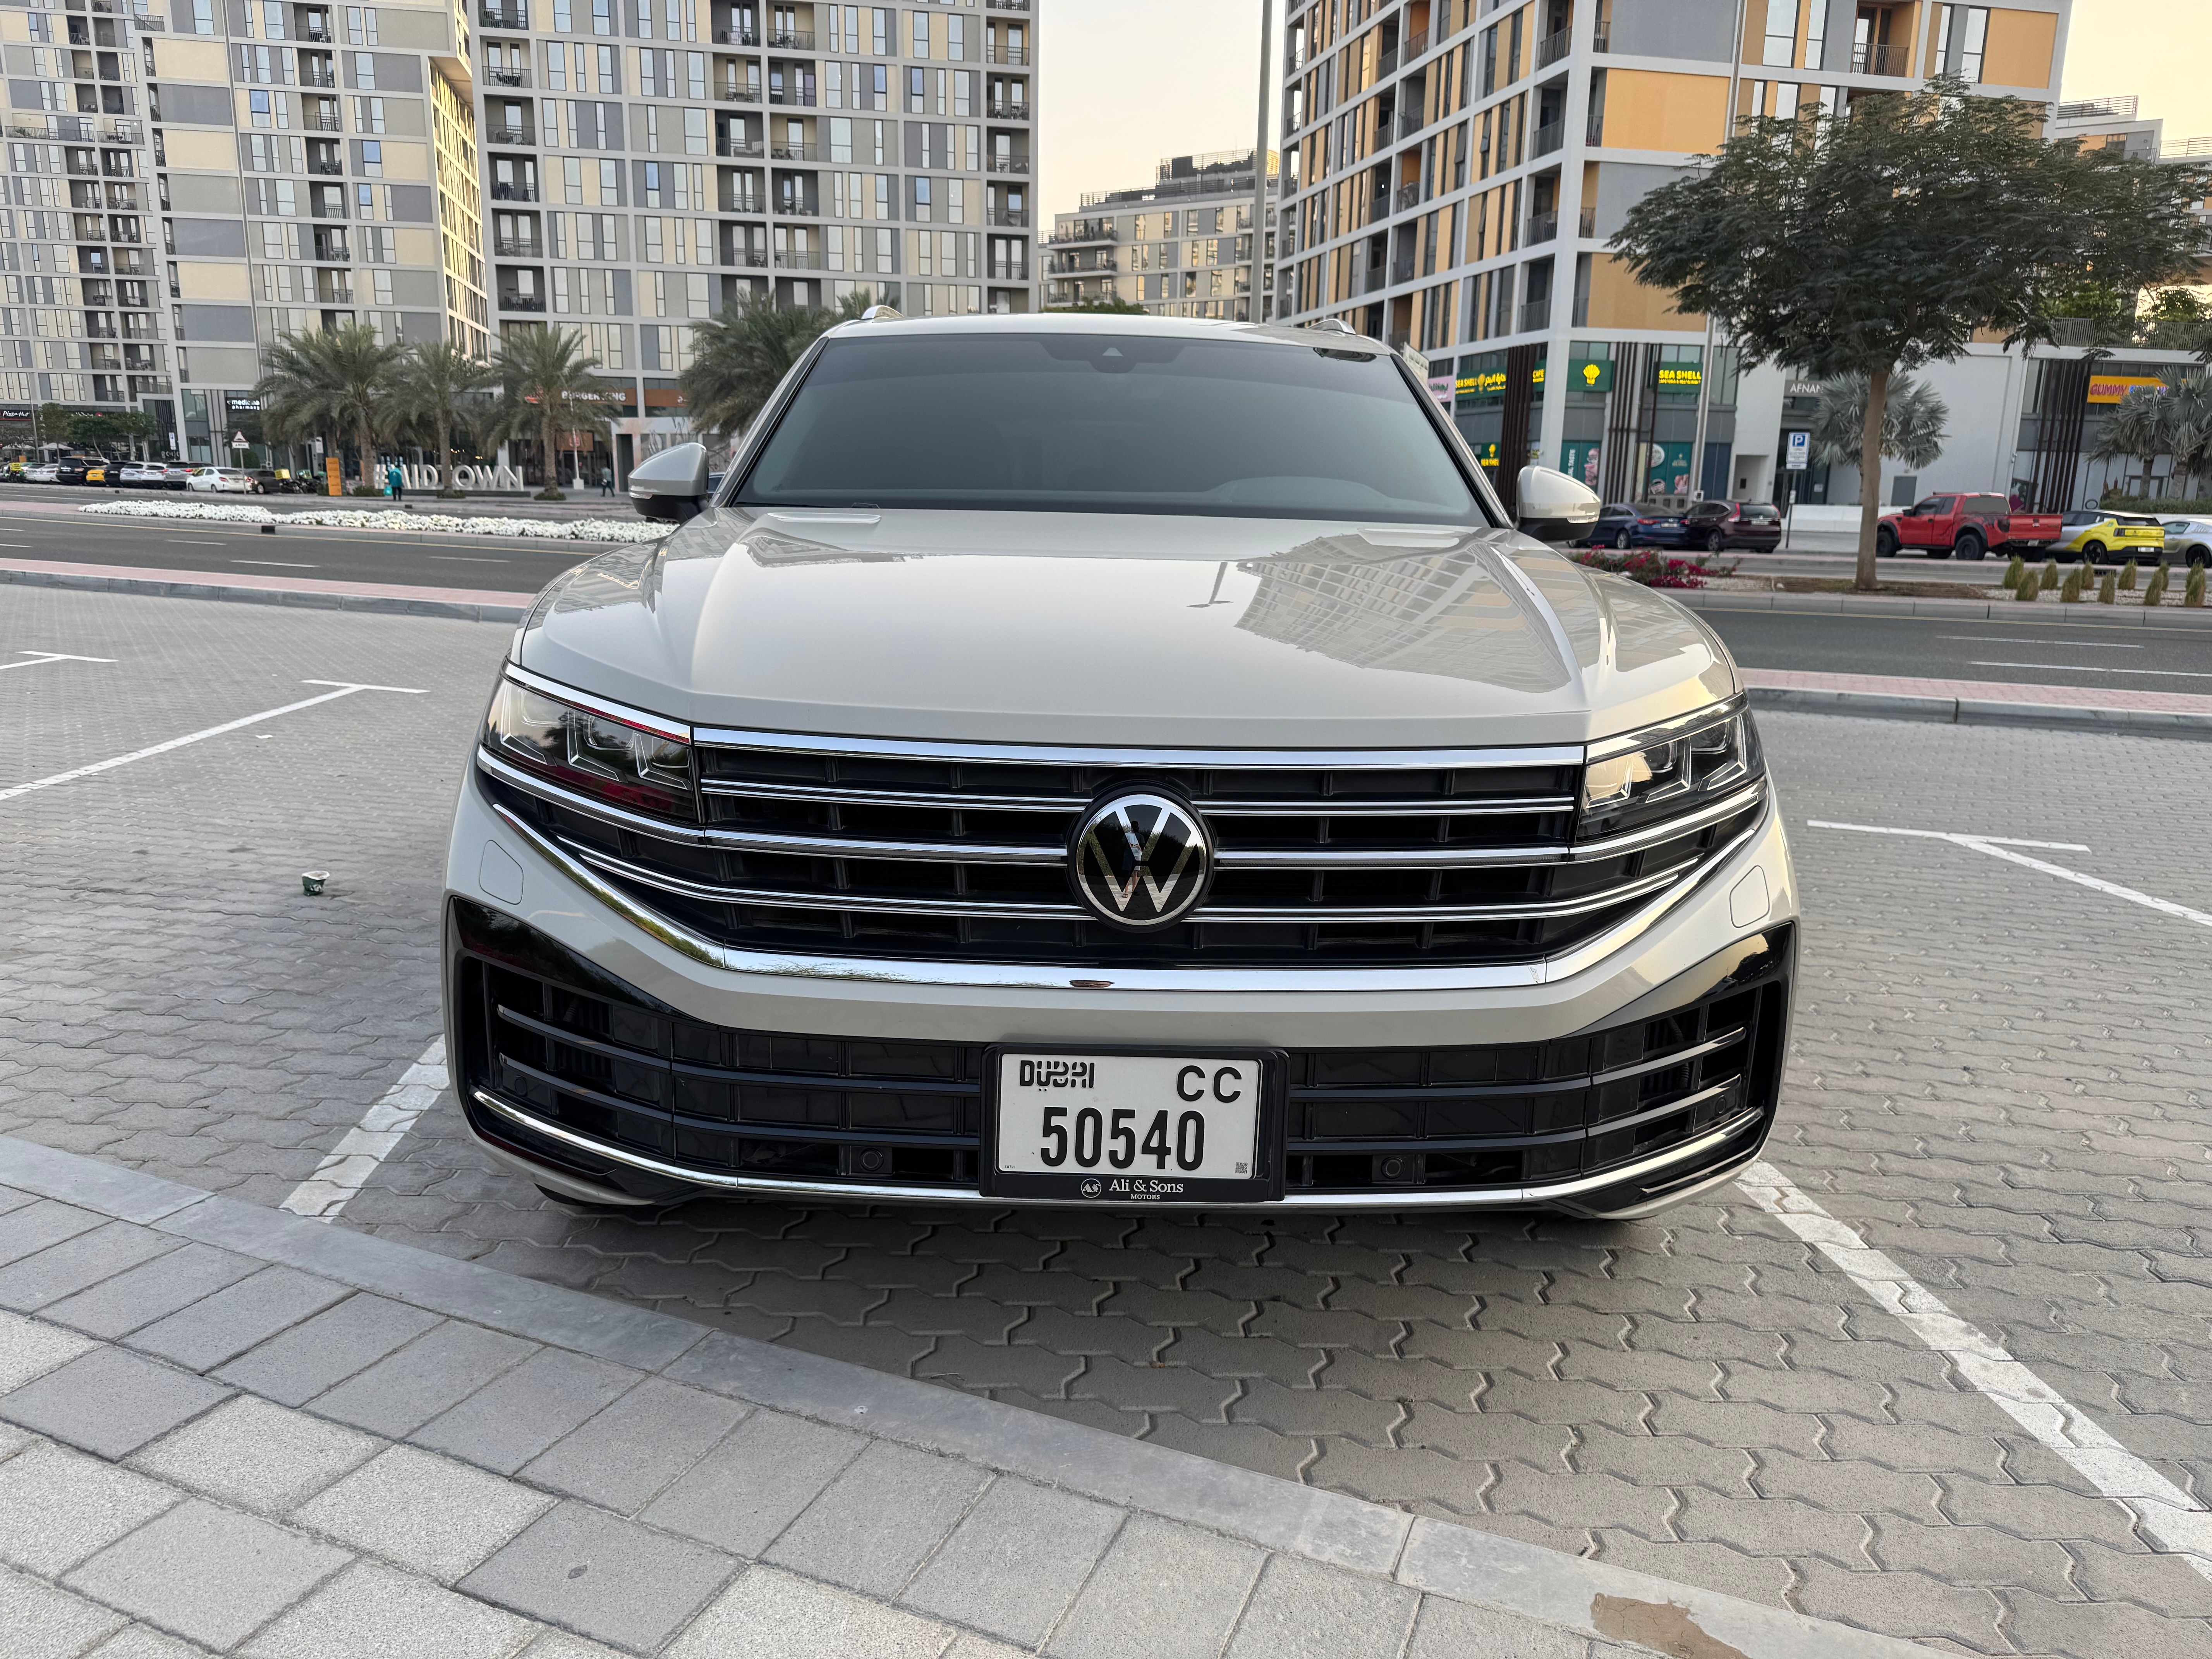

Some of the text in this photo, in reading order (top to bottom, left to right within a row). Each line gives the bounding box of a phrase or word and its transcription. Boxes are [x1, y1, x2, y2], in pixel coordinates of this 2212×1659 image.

[1659, 370, 1702, 380] SEA SHELL
[1455, 379, 1463, 388] SEA
[1464, 378, 1477, 387] SHELL
[2090, 383, 2127, 395] GUMMY
[1795, 436, 1803, 447] P
[374, 464, 524, 491] #IDOWN
[1041, 1106, 1205, 1171] 50540
[1109, 1179, 1130, 1192] Ali
[1133, 1179, 1147, 1192] &
[1149, 1180, 1184, 1193] Sons
